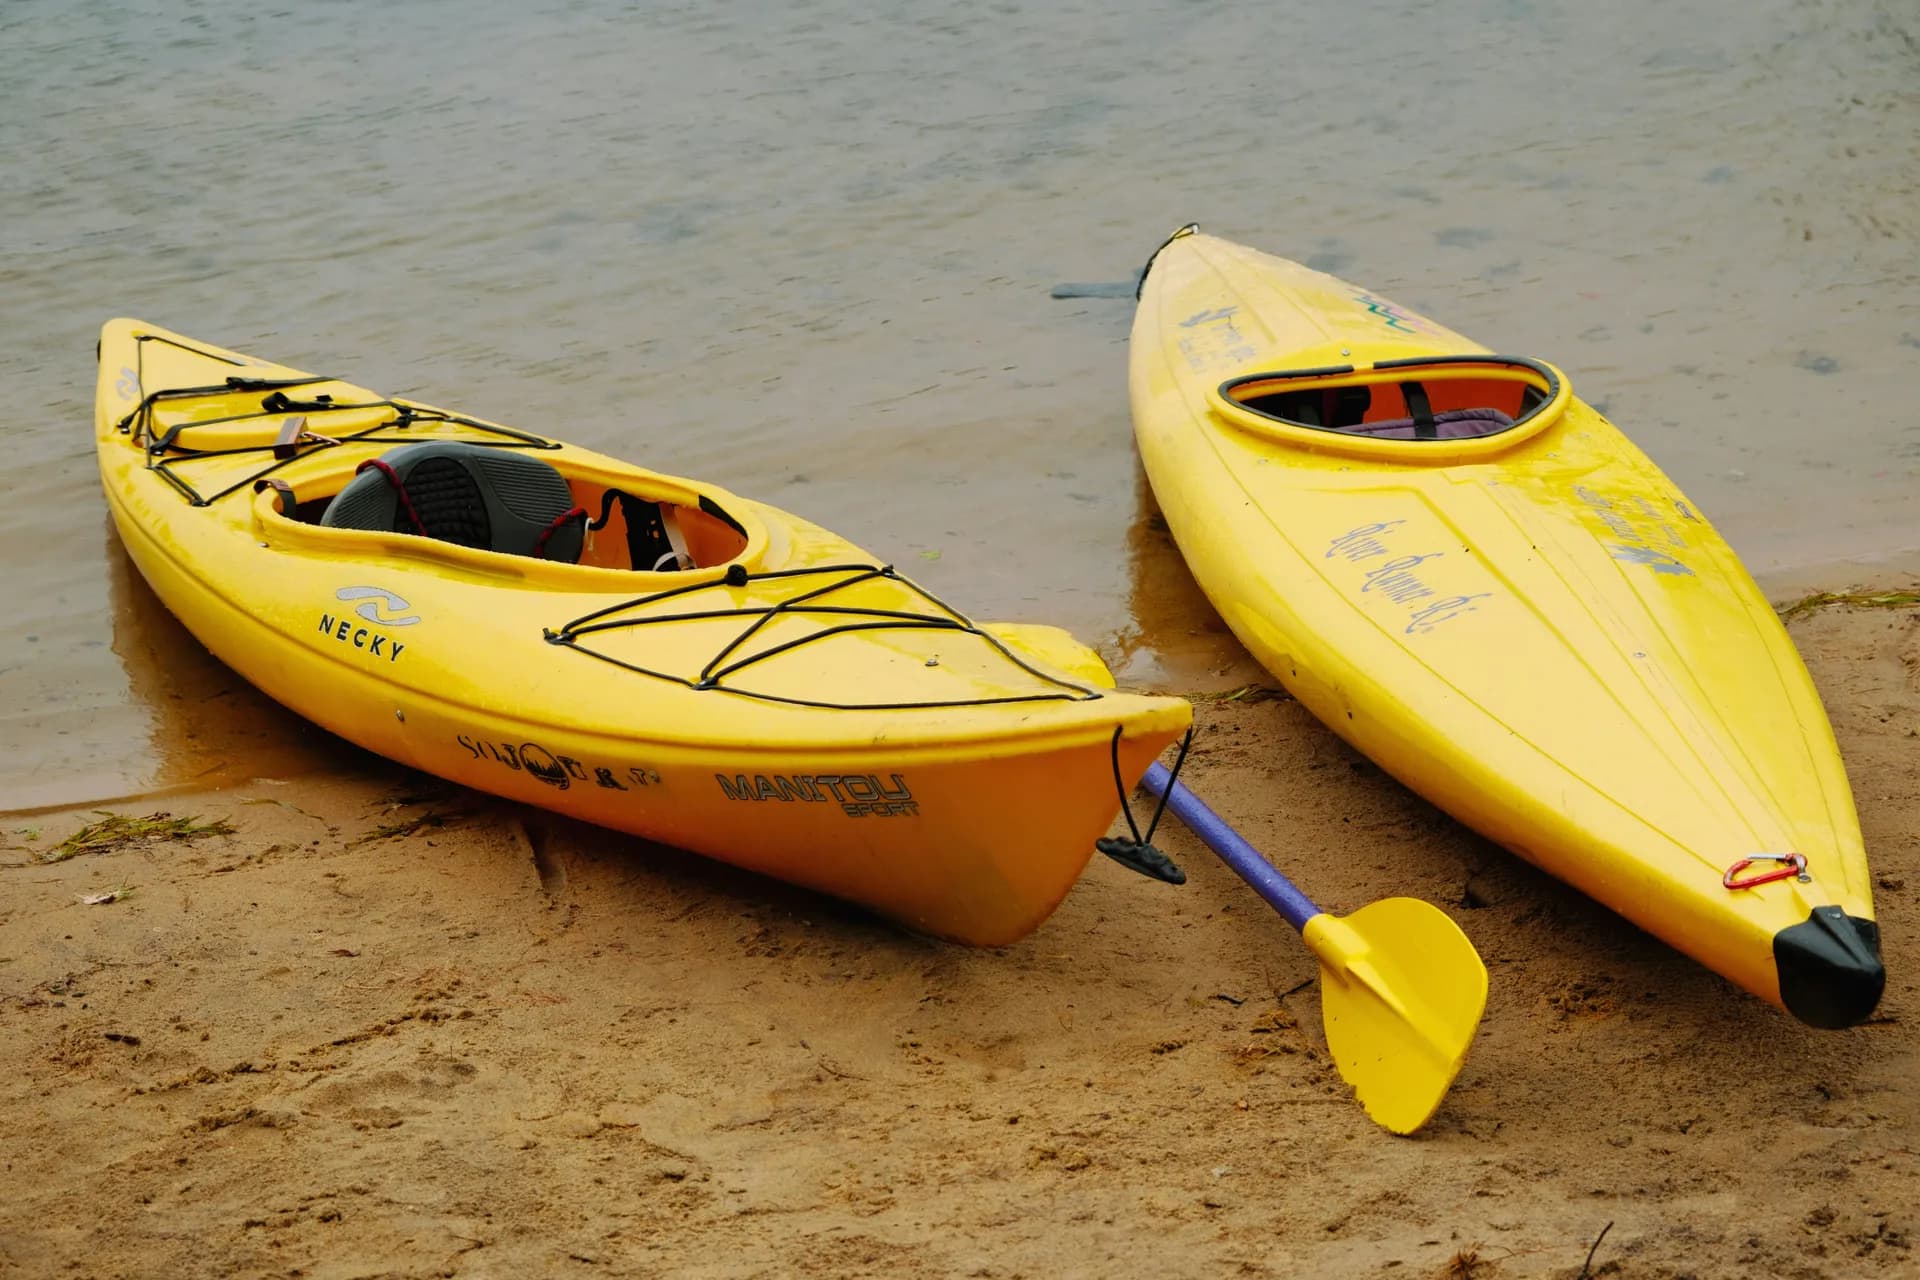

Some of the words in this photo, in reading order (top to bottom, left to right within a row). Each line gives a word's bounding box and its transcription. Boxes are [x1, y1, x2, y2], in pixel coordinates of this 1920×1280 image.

[318, 614, 404, 662] NECKY
[715, 774, 912, 802] MANITOU
[841, 801, 920, 818] SPORT
